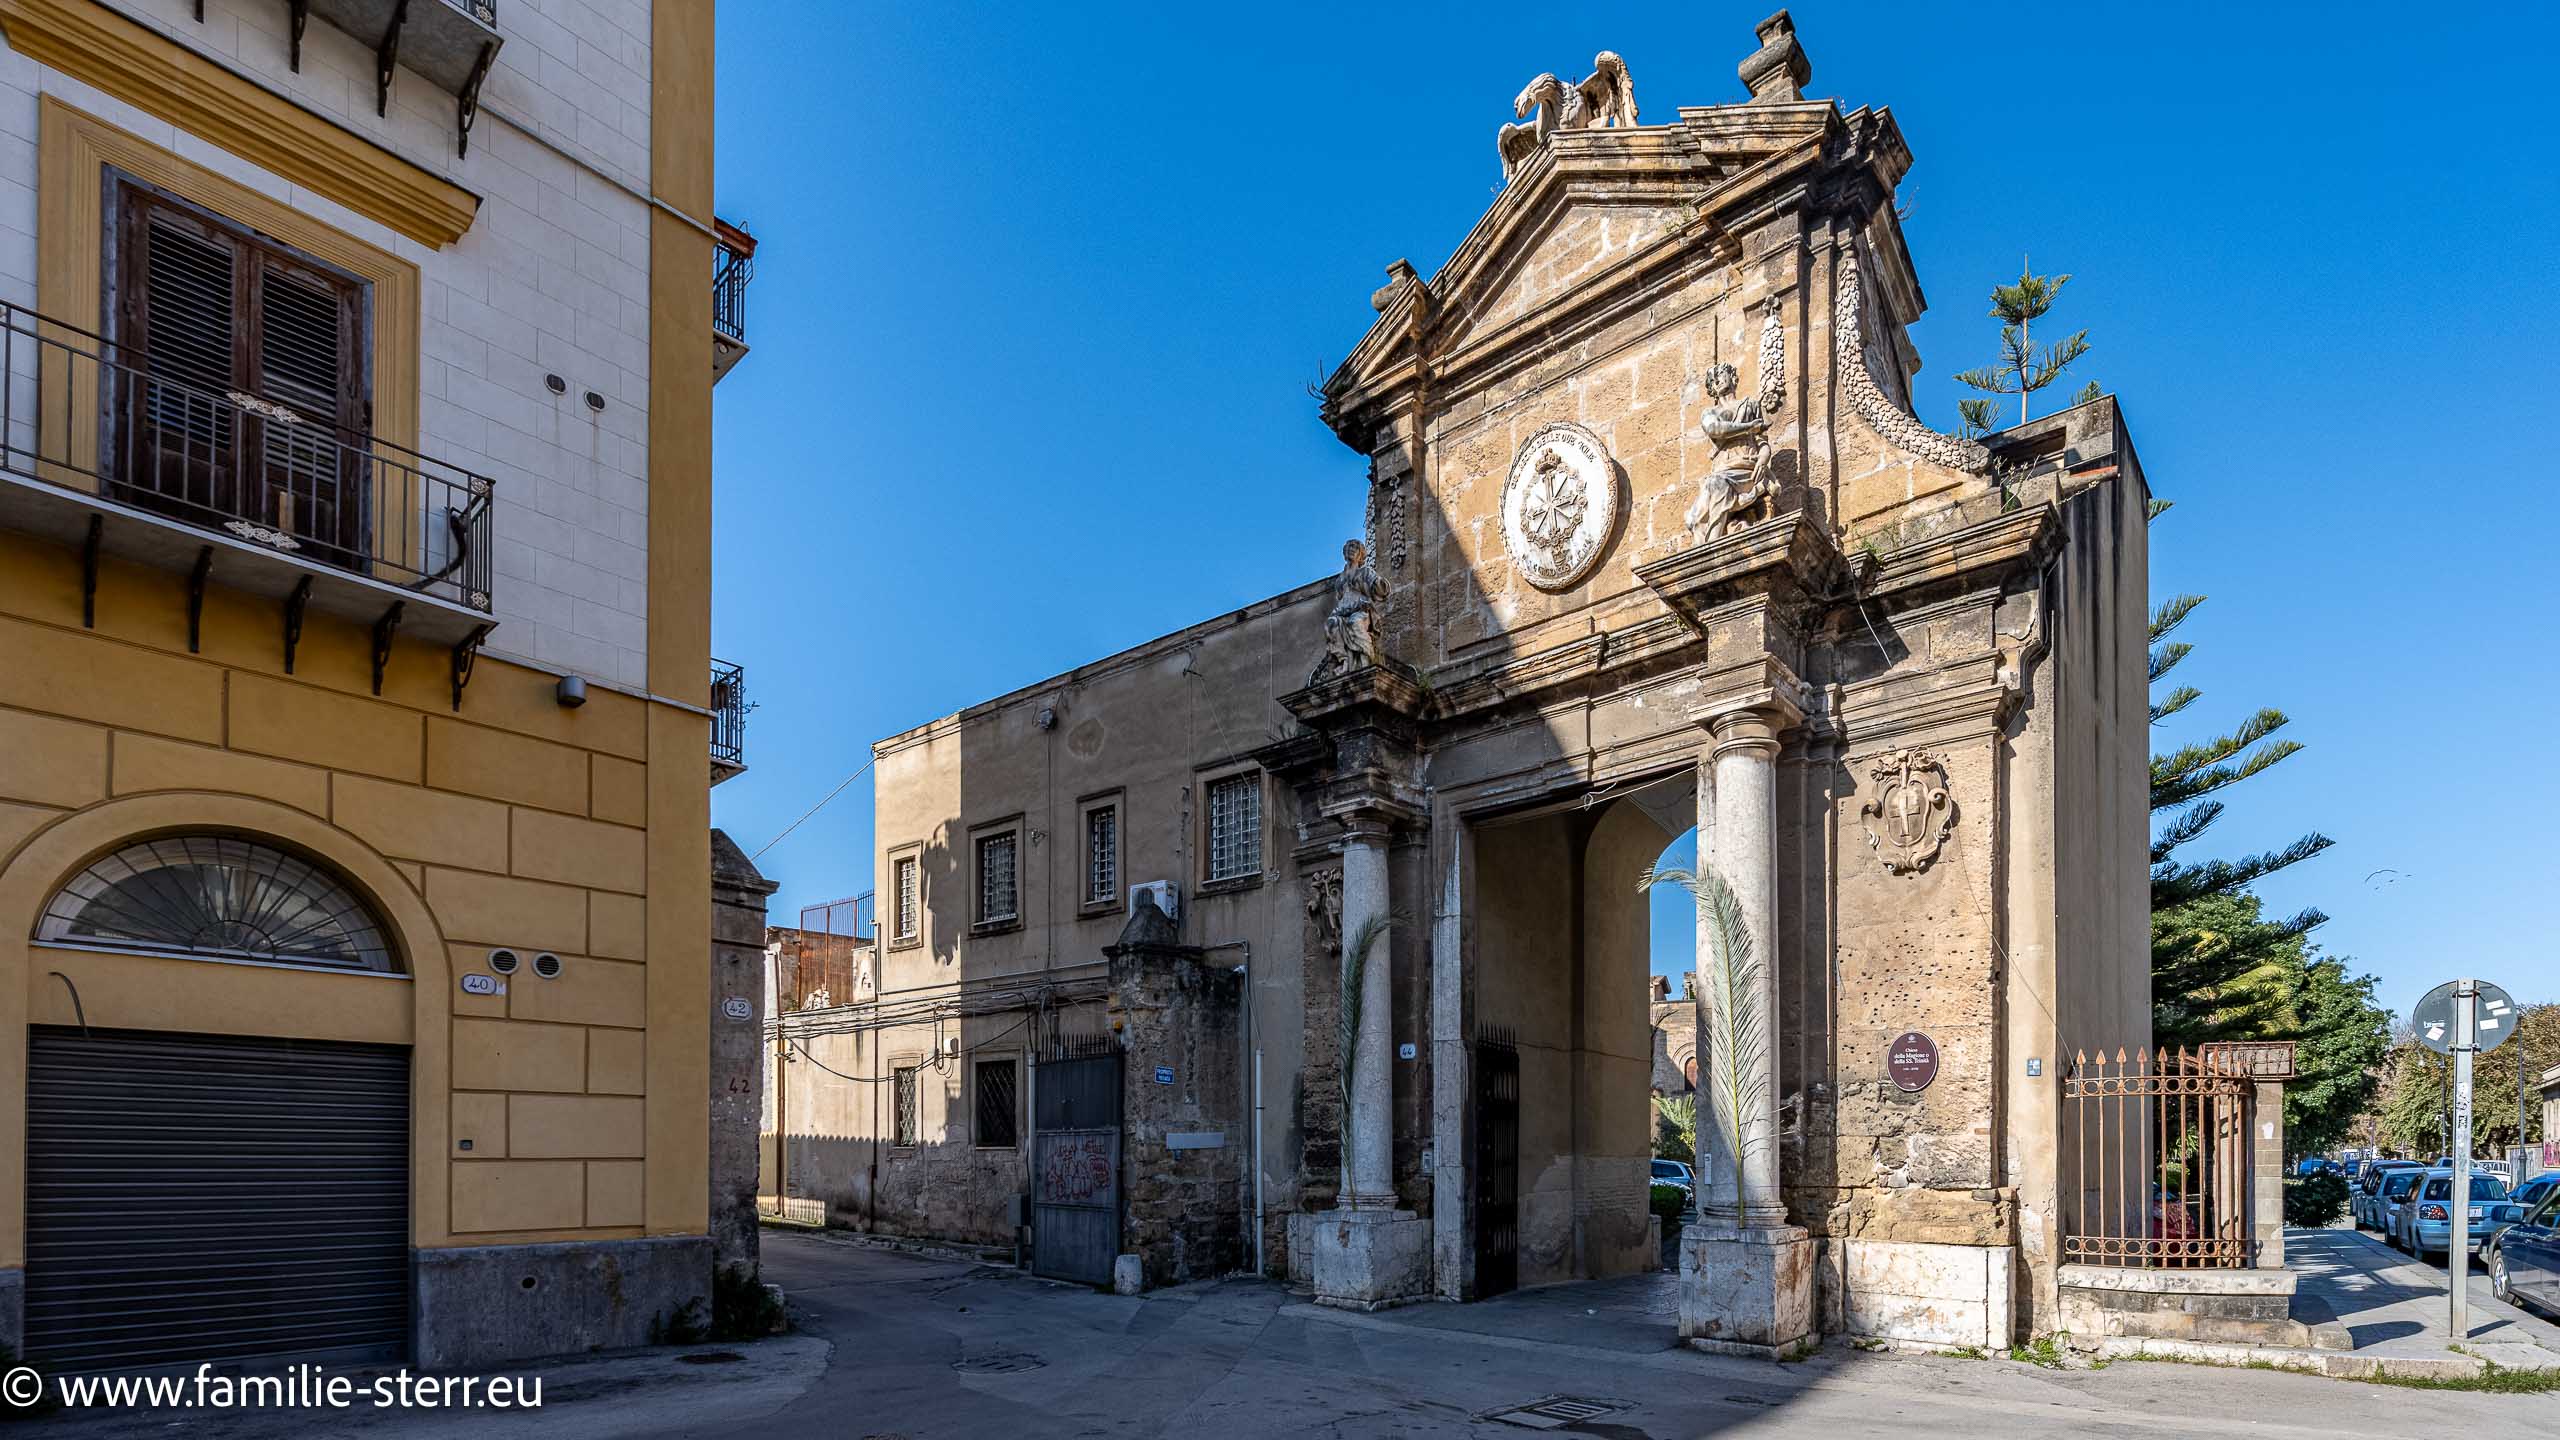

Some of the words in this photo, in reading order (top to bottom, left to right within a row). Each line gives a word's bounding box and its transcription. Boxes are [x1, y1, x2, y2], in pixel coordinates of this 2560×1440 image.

[468, 977, 489, 990] 40
[728, 1002, 746, 1014] 42
[728, 1077, 751, 1094] 42
